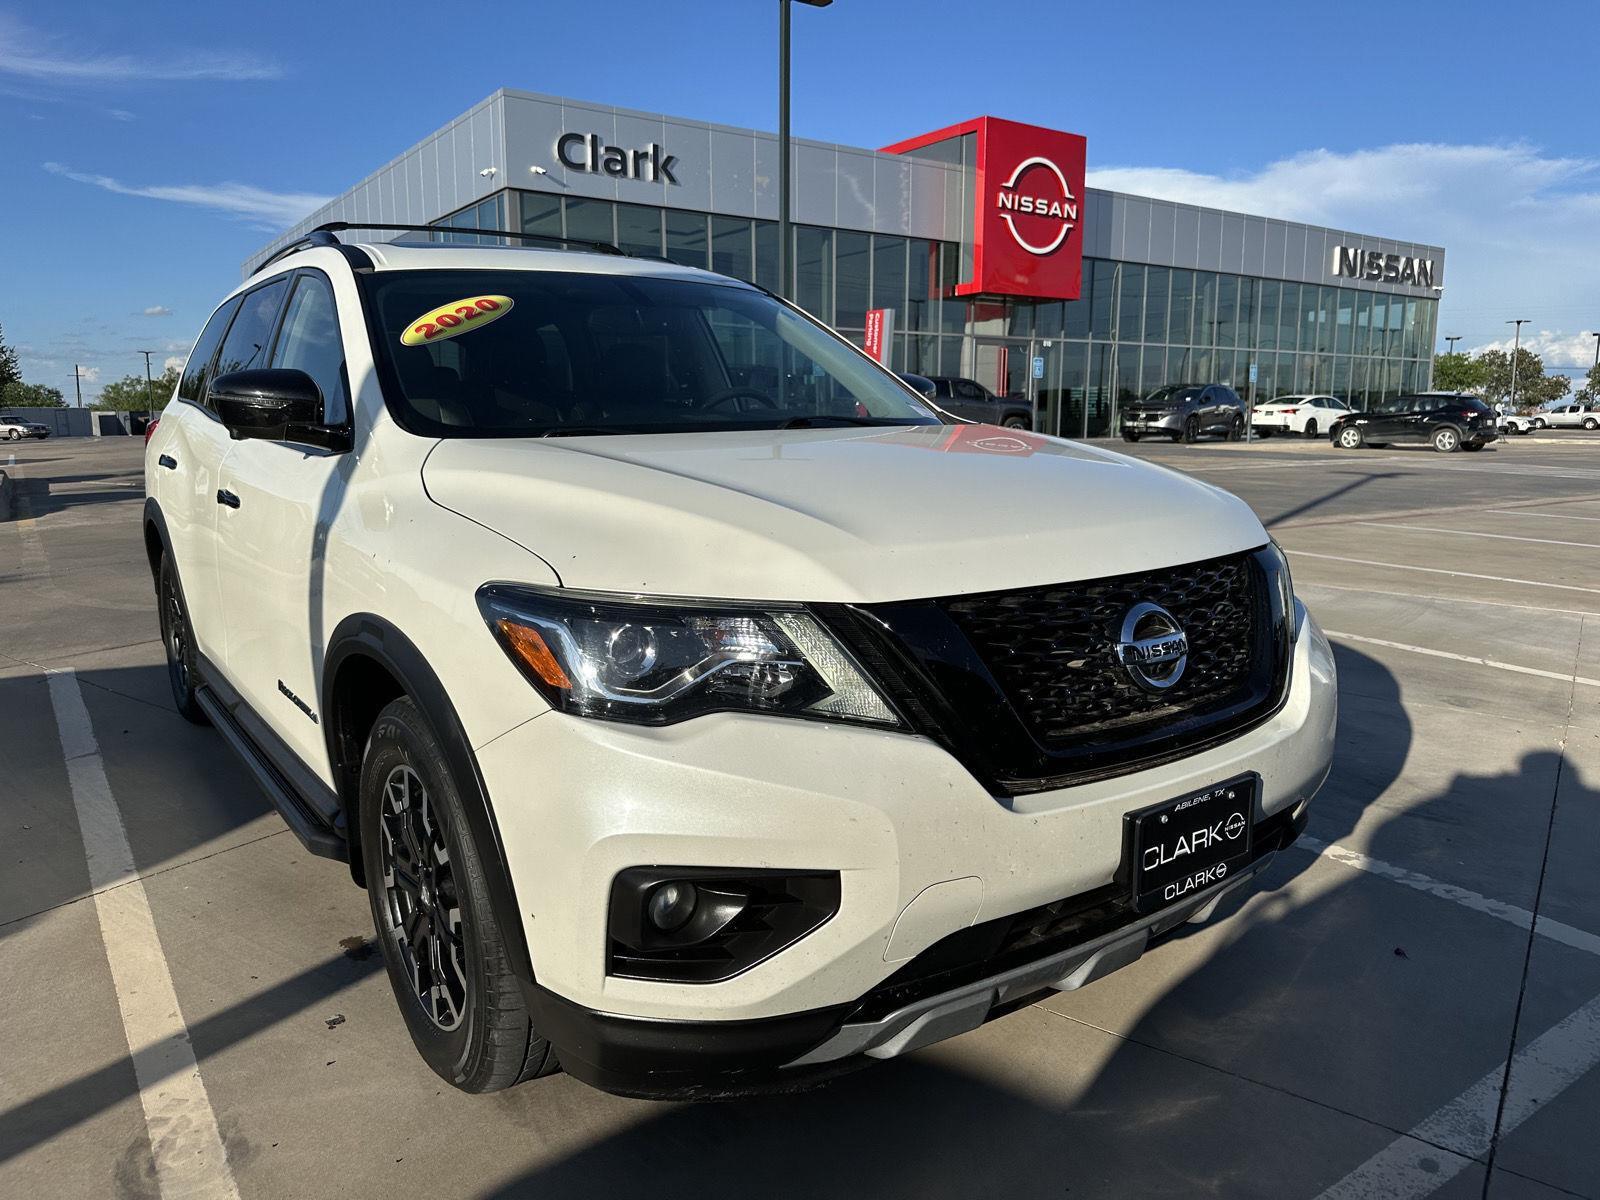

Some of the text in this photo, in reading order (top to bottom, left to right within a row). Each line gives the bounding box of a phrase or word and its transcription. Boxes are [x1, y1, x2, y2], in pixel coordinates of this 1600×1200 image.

[556, 132, 678, 184] Clark
[997, 192, 1077, 219] NISSAN
[1333, 245, 1434, 287] NISSAN
[414, 299, 502, 339] 2020
[866, 313, 874, 346] Parking
[1130, 638, 1187, 660] NISSAN
[1174, 788, 1225, 812] ABILENE, TX
[1224, 820, 1246, 832] NISSAN
[1143, 820, 1223, 871] CLARK
[1164, 867, 1216, 900] CLARK
